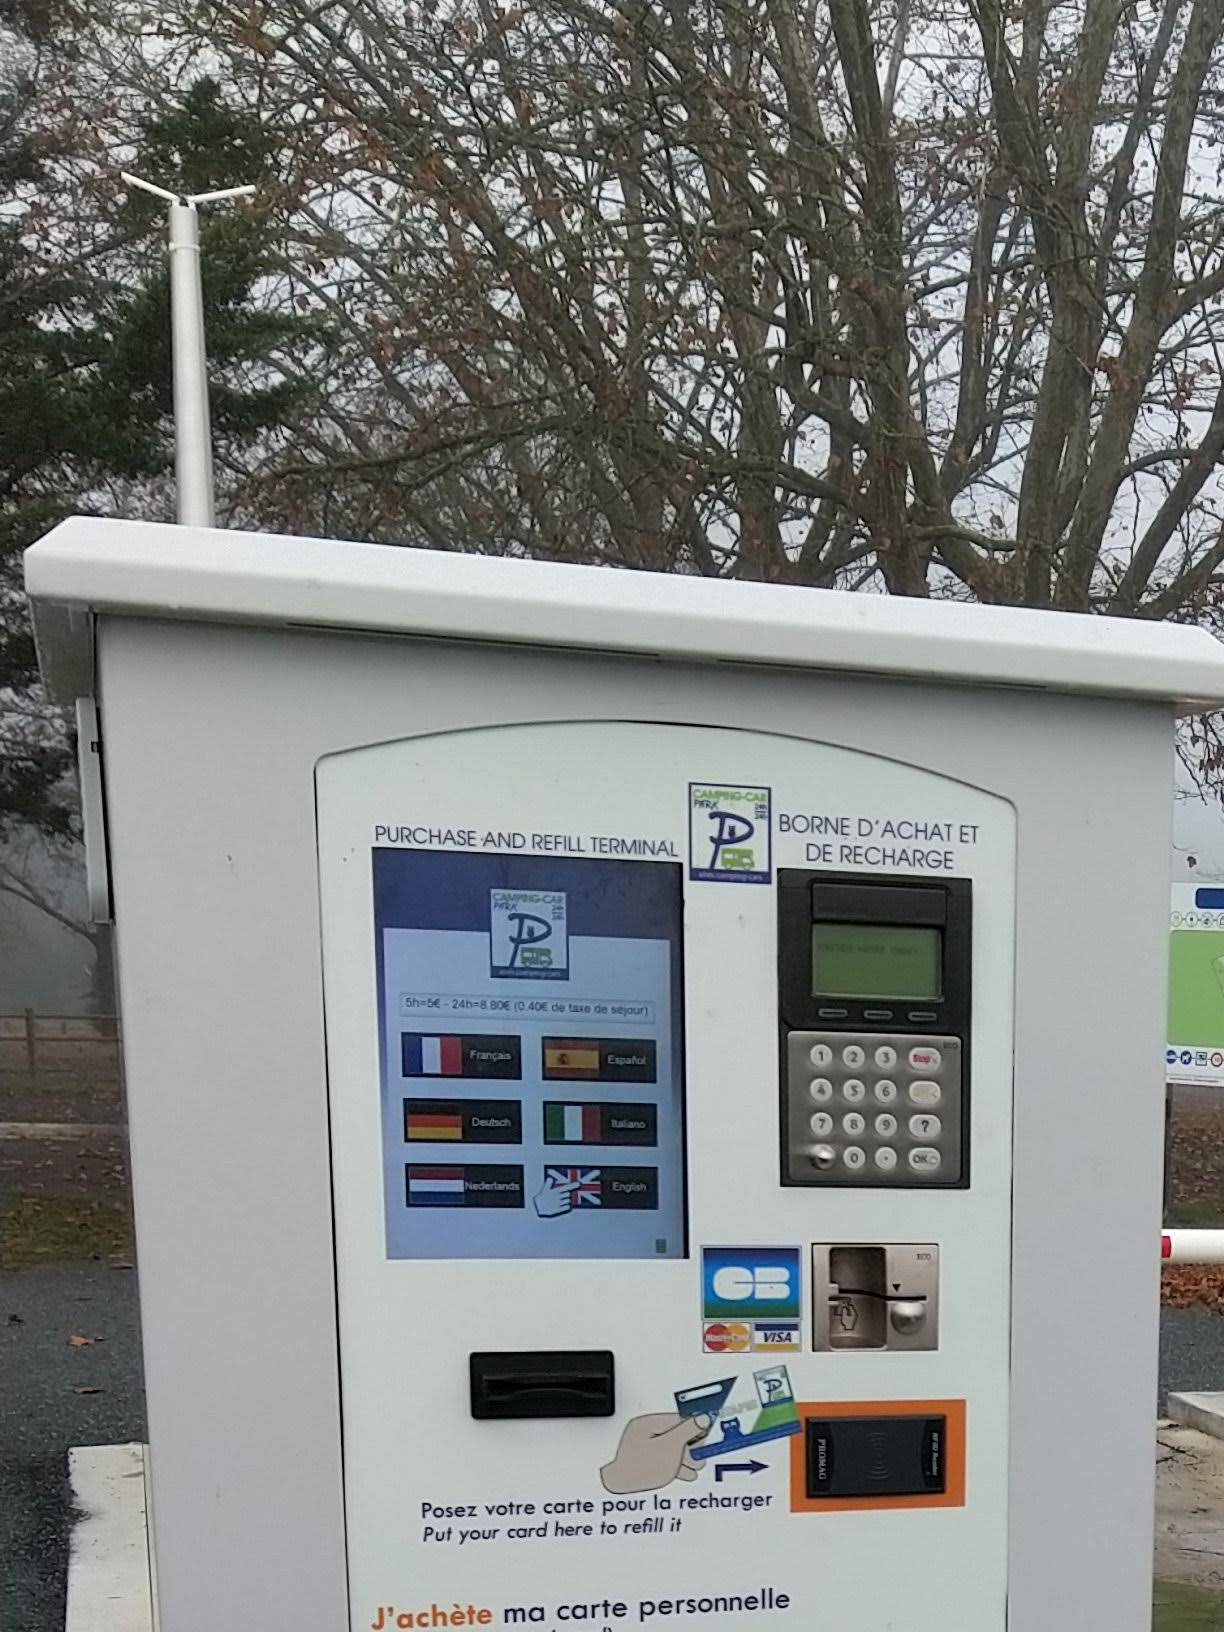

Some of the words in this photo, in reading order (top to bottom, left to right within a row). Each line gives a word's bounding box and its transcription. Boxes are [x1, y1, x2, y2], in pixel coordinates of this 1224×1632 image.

[779, 814, 850, 836] BORNE
[857, 818, 951, 841] D'ACHAT
[959, 825, 979, 844] ET
[375, 826, 476, 846] PURCHASE
[483, 831, 526, 849] AND
[532, 834, 585, 852] REFILL
[590, 836, 679, 857] TERMINAL
[806, 844, 832, 863] DE
[840, 846, 955, 869] RECHARGE
[405, 997, 440, 1009] 5h=5€
[551, 1002, 565, 1013] de
[569, 1003, 591, 1014] taxe
[595, 1003, 608, 1015] de
[469, 1049, 512, 1062] Français
[607, 1054, 647, 1067] Español
[818, 1051, 824, 1062] 1
[851, 1052, 858, 1063] 2
[883, 1052, 890, 1063] 3
[817, 1085, 826, 1096] 4
[851, 1086, 858, 1097] 5
[882, 1086, 890, 1097] 6
[471, 1117, 511, 1128] Deutsch
[611, 1119, 647, 1130] Italiano
[818, 1119, 825, 1130] 7
[850, 1119, 858, 1130] 8
[882, 1120, 891, 1131] 9
[921, 1120, 929, 1133] ?
[850, 1152, 859, 1164] 0
[464, 1181, 520, 1192] Nederlands
[612, 1181, 647, 1194] English
[713, 1266, 791, 1300] CB
[763, 1331, 792, 1343] VISA
[421, 1502, 477, 1519] Posez
[485, 1501, 535, 1517] votre
[543, 1499, 594, 1515] carte
[602, 1498, 646, 1517] pour
[654, 1494, 672, 1511] la
[679, 1493, 773, 1512] recharger
[423, 1525, 453, 1542] Put
[459, 1527, 499, 1545] your
[507, 1522, 547, 1539] card
[554, 1521, 593, 1537] here
[601, 1522, 617, 1536] to
[624, 1517, 664, 1534] refill
[670, 1517, 682, 1533] it
[371, 1603, 493, 1631] J'achète
[504, 1606, 545, 1624] ma
[556, 1599, 628, 1621] carte
[639, 1588, 790, 1622] personnelle
